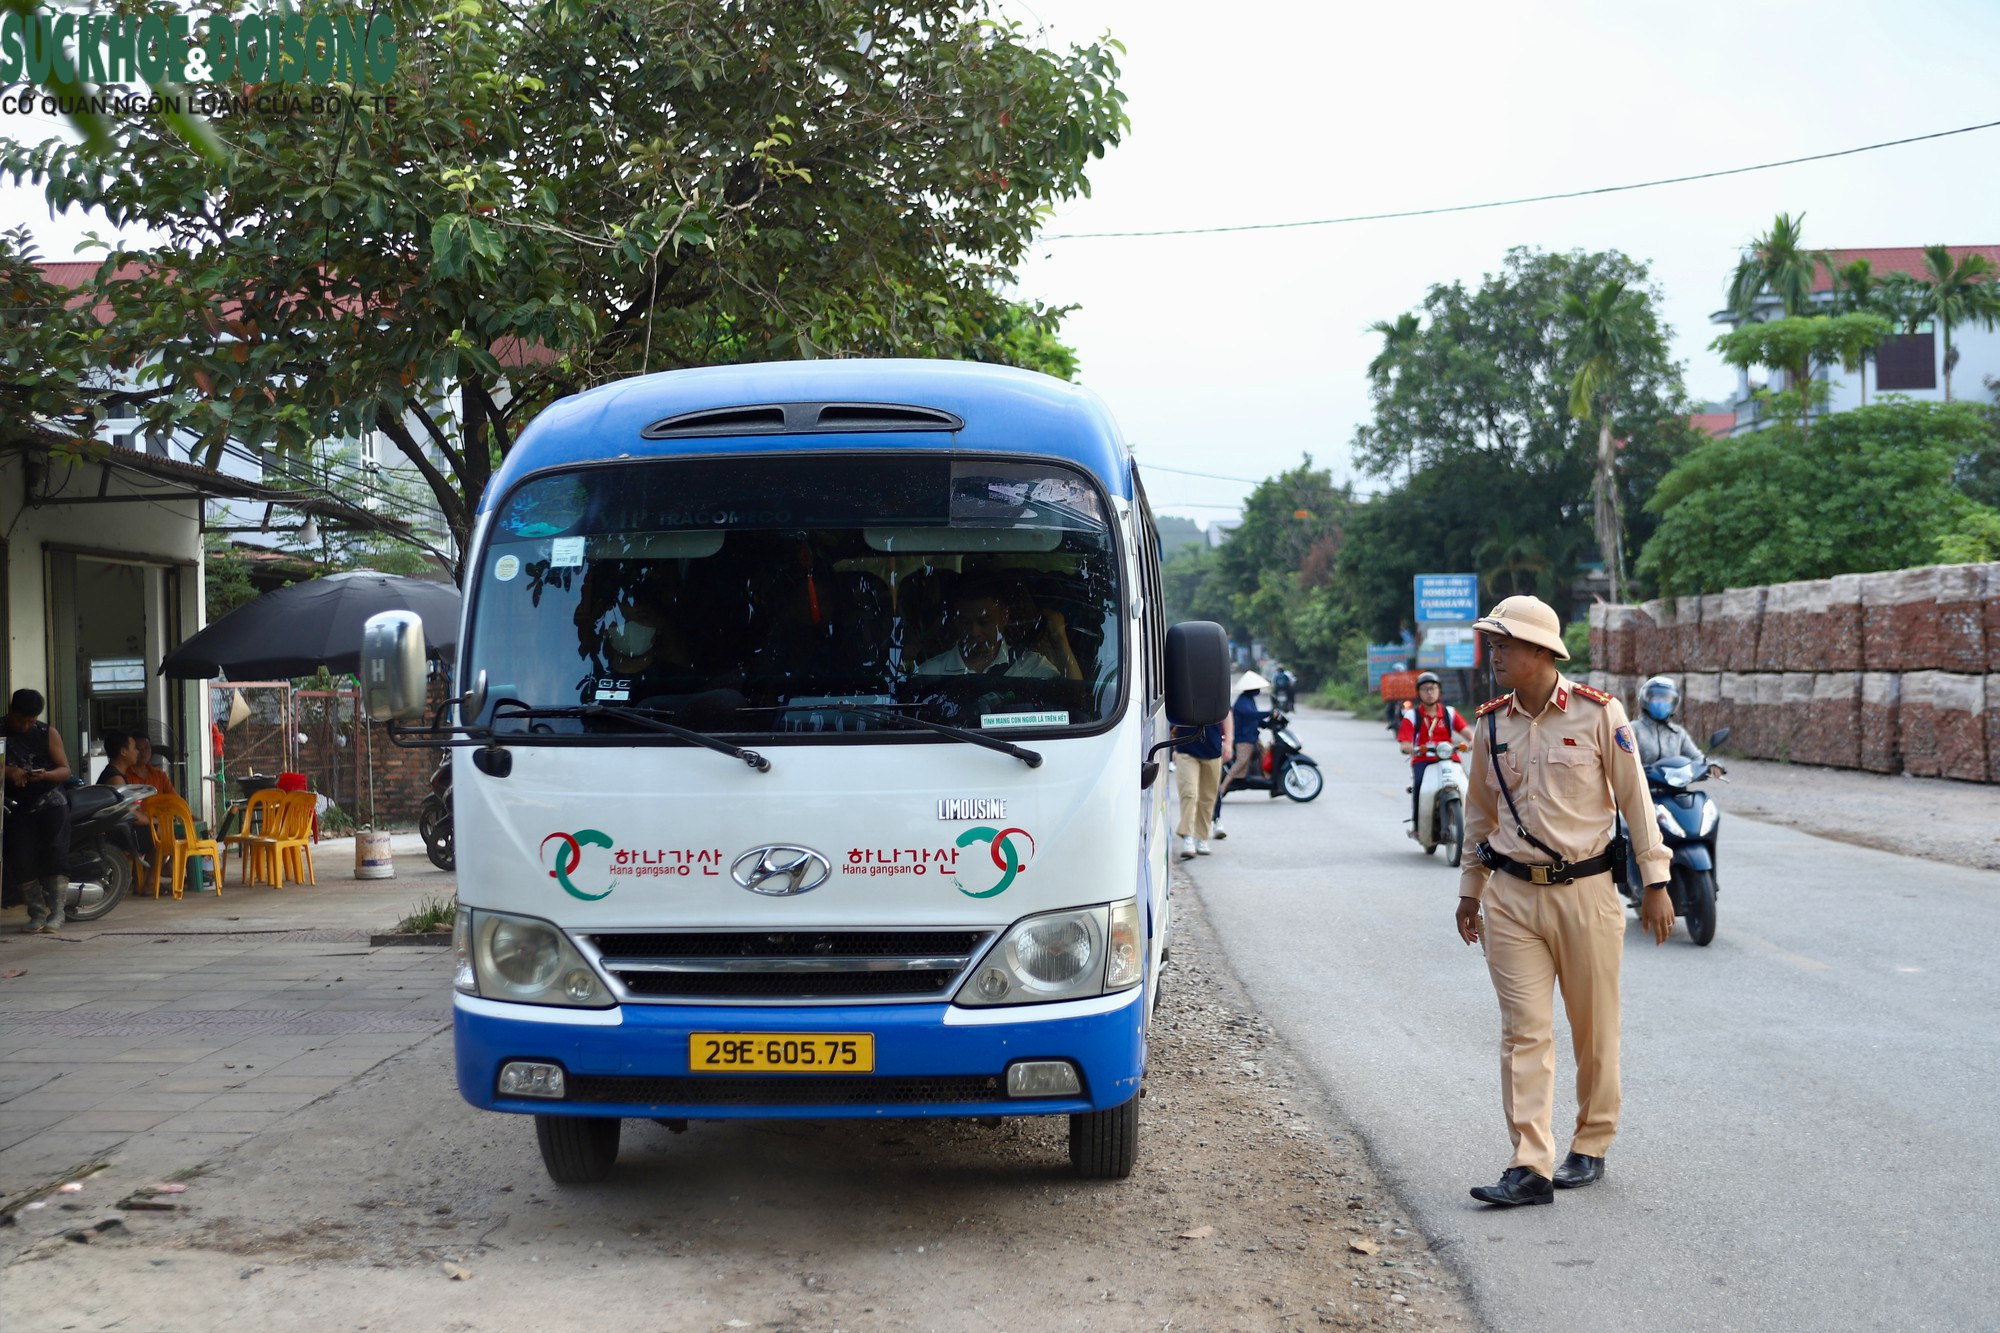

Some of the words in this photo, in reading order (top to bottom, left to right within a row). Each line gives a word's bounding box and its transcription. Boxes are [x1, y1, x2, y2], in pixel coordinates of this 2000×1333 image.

[1011, 716, 1021, 724] CON
[938, 799, 1007, 820] LIMOUSINE
[609, 864, 633, 875] Hana
[635, 865, 676, 877] gangsan
[614, 849, 722, 876] 하나강산
[842, 864, 867, 875] Hana
[870, 864, 911, 876] gangsan
[847, 848, 960, 875] 하나강산
[706, 1040, 857, 1064] 29E-605.75
